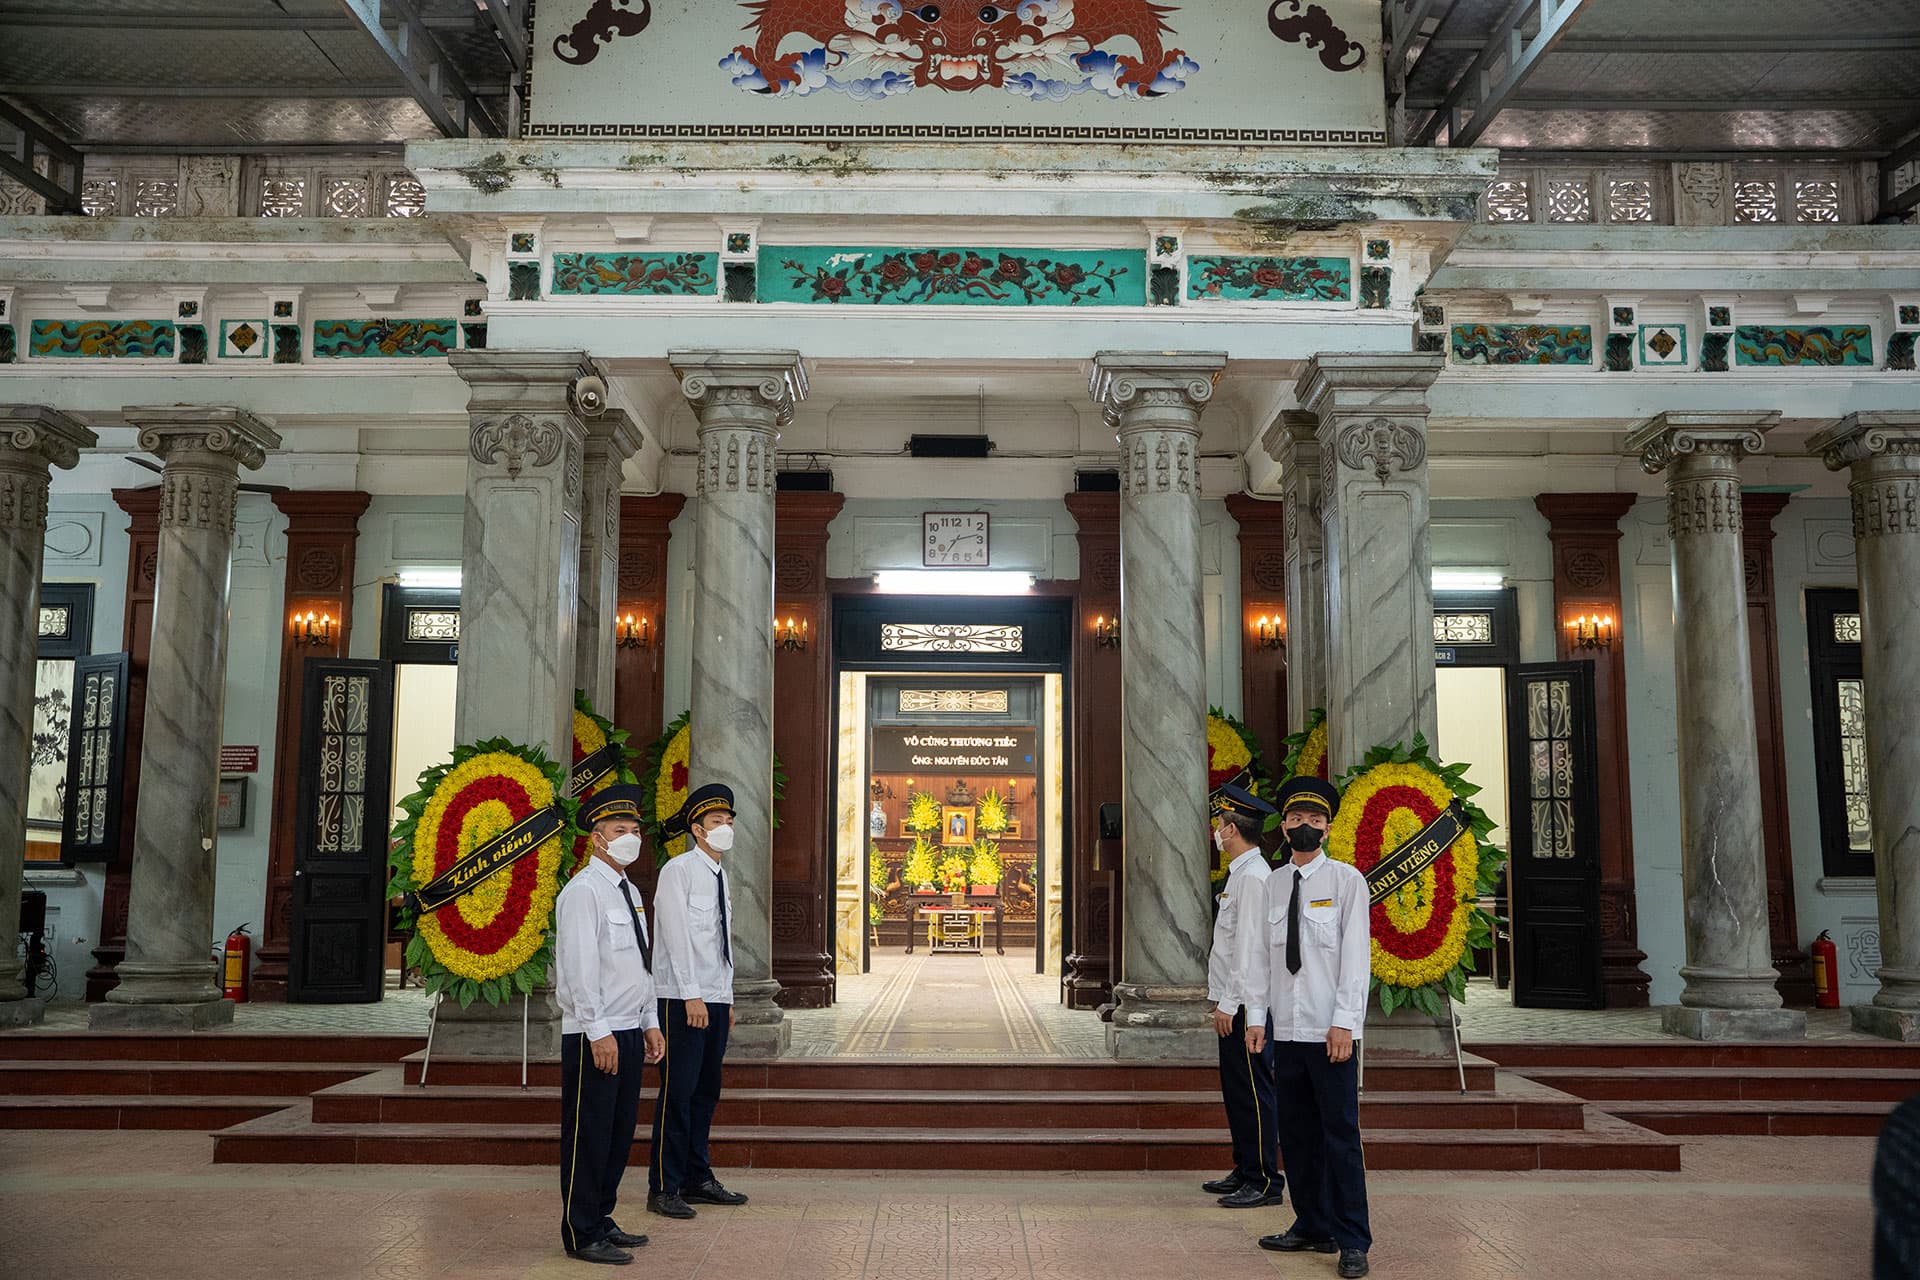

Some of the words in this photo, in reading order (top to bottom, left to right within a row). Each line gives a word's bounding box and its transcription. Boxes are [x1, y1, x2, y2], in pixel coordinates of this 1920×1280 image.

[929, 522, 939, 532] 10
[941, 518, 948, 527] 11
[951, 518, 962, 527] 12
[976, 522, 984, 531] 2
[929, 535, 936, 544] 9
[976, 535, 984, 544] 3
[929, 549, 936, 558] 8
[941, 553, 947, 562] 7
[952, 553, 960, 561] 6
[964, 553, 972, 562] 5
[976, 549, 983, 557] 4
[903, 735, 919, 746] VÔ
[920, 735, 948, 747] CÙNG
[949, 736, 992, 747] THƯƠNG
[993, 735, 1017, 747] TIẾC
[447, 857, 490, 892] Kính
[492, 831, 534, 862] viếng
[1368, 869, 1400, 894] ÍNH
[1397, 839, 1440, 874] VIẾNG
